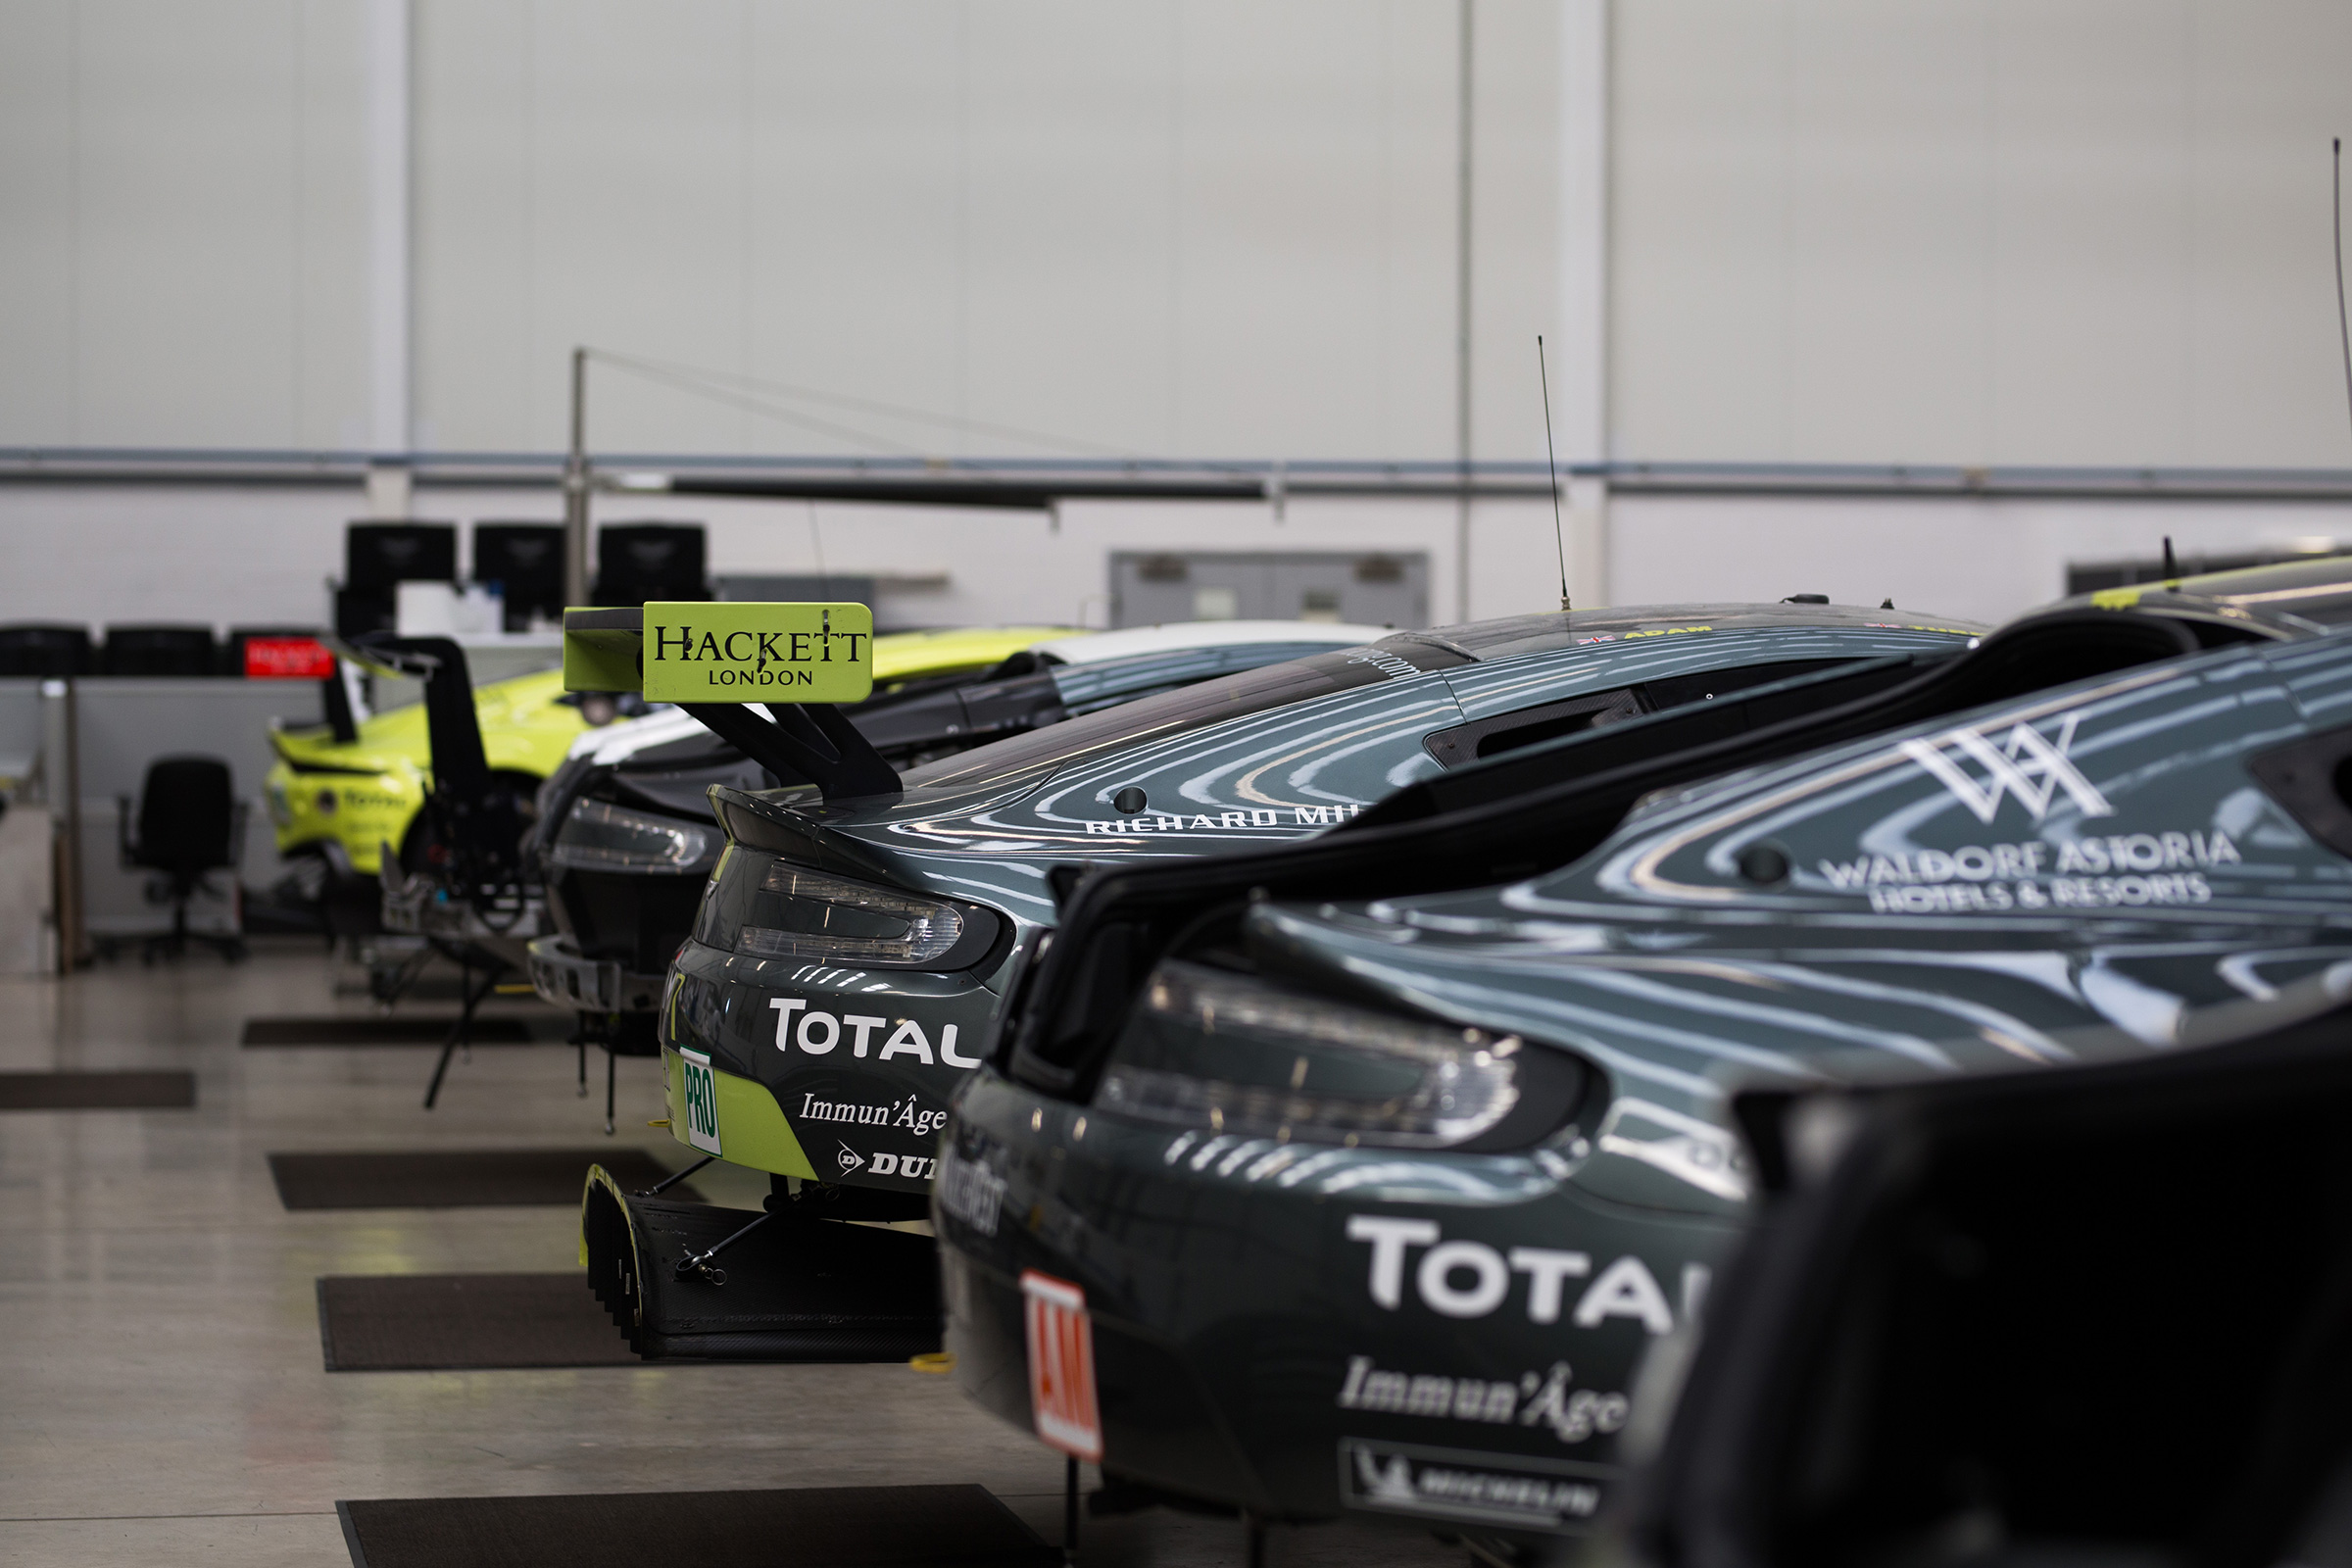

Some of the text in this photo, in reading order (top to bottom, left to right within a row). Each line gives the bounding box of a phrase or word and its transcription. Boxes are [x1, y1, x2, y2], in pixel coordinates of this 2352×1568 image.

[655, 626, 867, 662] HACKETT
[1625, 625, 1713, 639] ADAM
[710, 670, 812, 686] LONDON
[1086, 808, 1278, 834] RICHARD
[1818, 829, 2241, 889] WALDORF ASTORIA
[1868, 880, 2013, 913] HOTELS
[2051, 871, 2213, 907] RESORTS
[769, 998, 981, 1069] TOTAL
[685, 1061, 715, 1138] PRO
